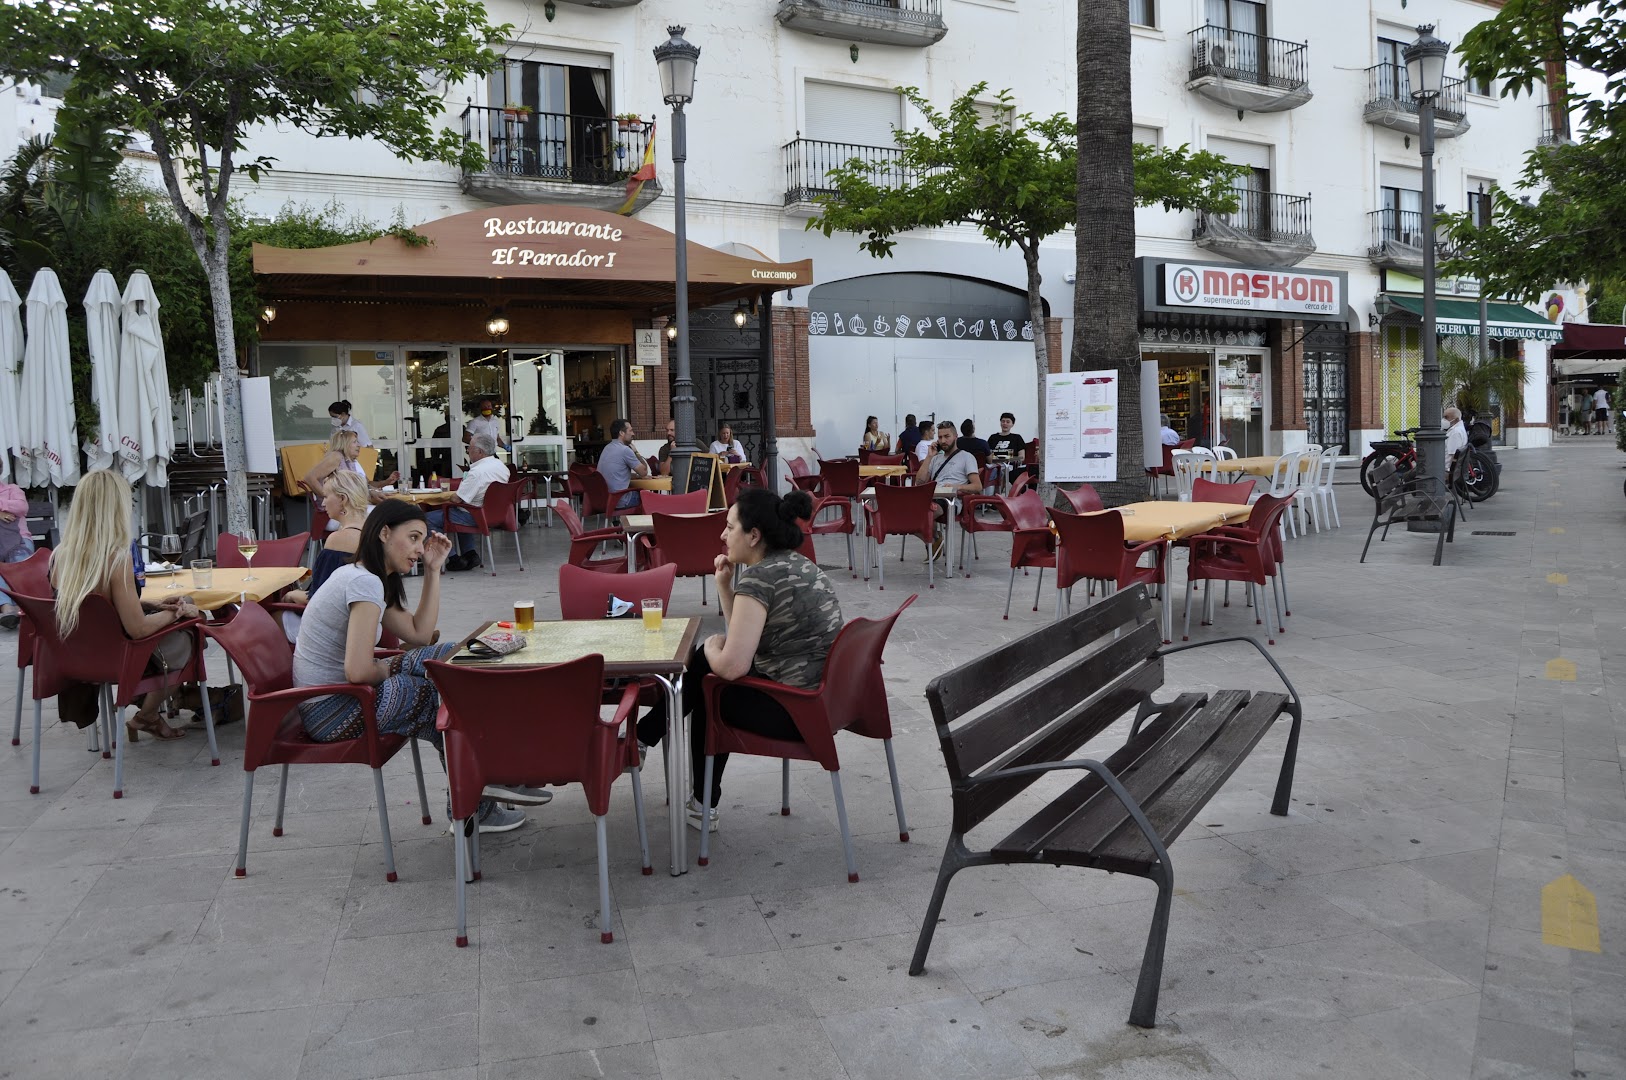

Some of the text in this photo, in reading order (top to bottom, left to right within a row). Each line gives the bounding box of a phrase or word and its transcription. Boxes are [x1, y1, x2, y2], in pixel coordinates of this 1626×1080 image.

[484, 217, 622, 242] Restaurante
[491, 247, 616, 268] El Parador I
[751, 268, 797, 281] Cruzcampo
[1203, 270, 1333, 303] MASKOM
[1203, 296, 1251, 306] supermercados
[1320, 303, 1329, 311] de
[1469, 326, 1502, 337] LIBERIA
[1503, 328, 1536, 339] REGALOS
